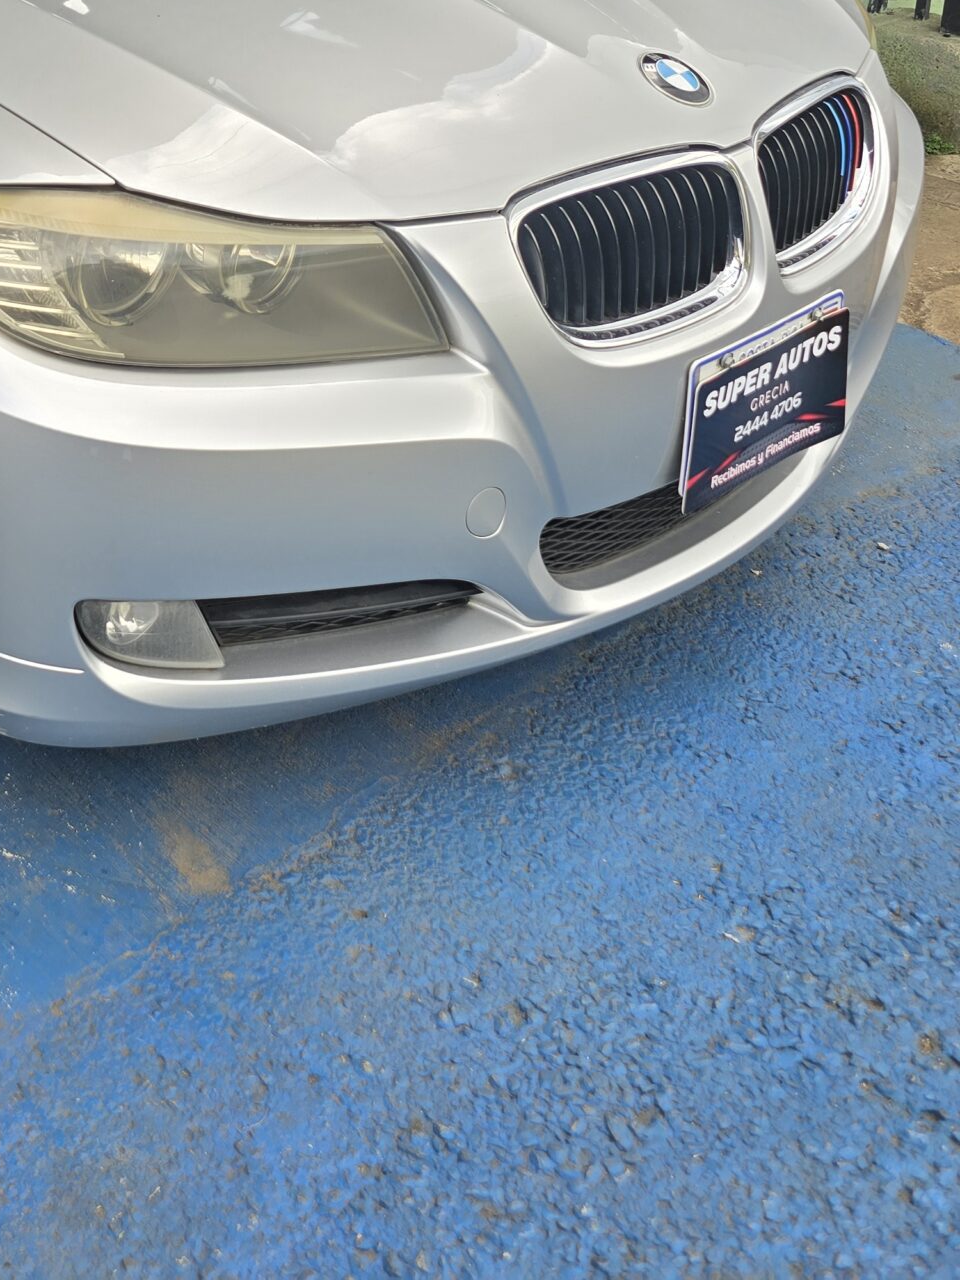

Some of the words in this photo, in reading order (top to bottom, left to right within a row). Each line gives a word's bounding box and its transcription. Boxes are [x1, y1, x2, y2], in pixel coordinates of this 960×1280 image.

[703, 361, 773, 418] SUPER
[774, 325, 843, 380] AUTOS
[750, 380, 790, 412] GRECIA
[733, 411, 769, 443] 2444
[770, 391, 803, 420] 4706
[710, 456, 757, 489] Recibimos
[757, 452, 765, 465] y
[765, 422, 822, 459] Financiamos
